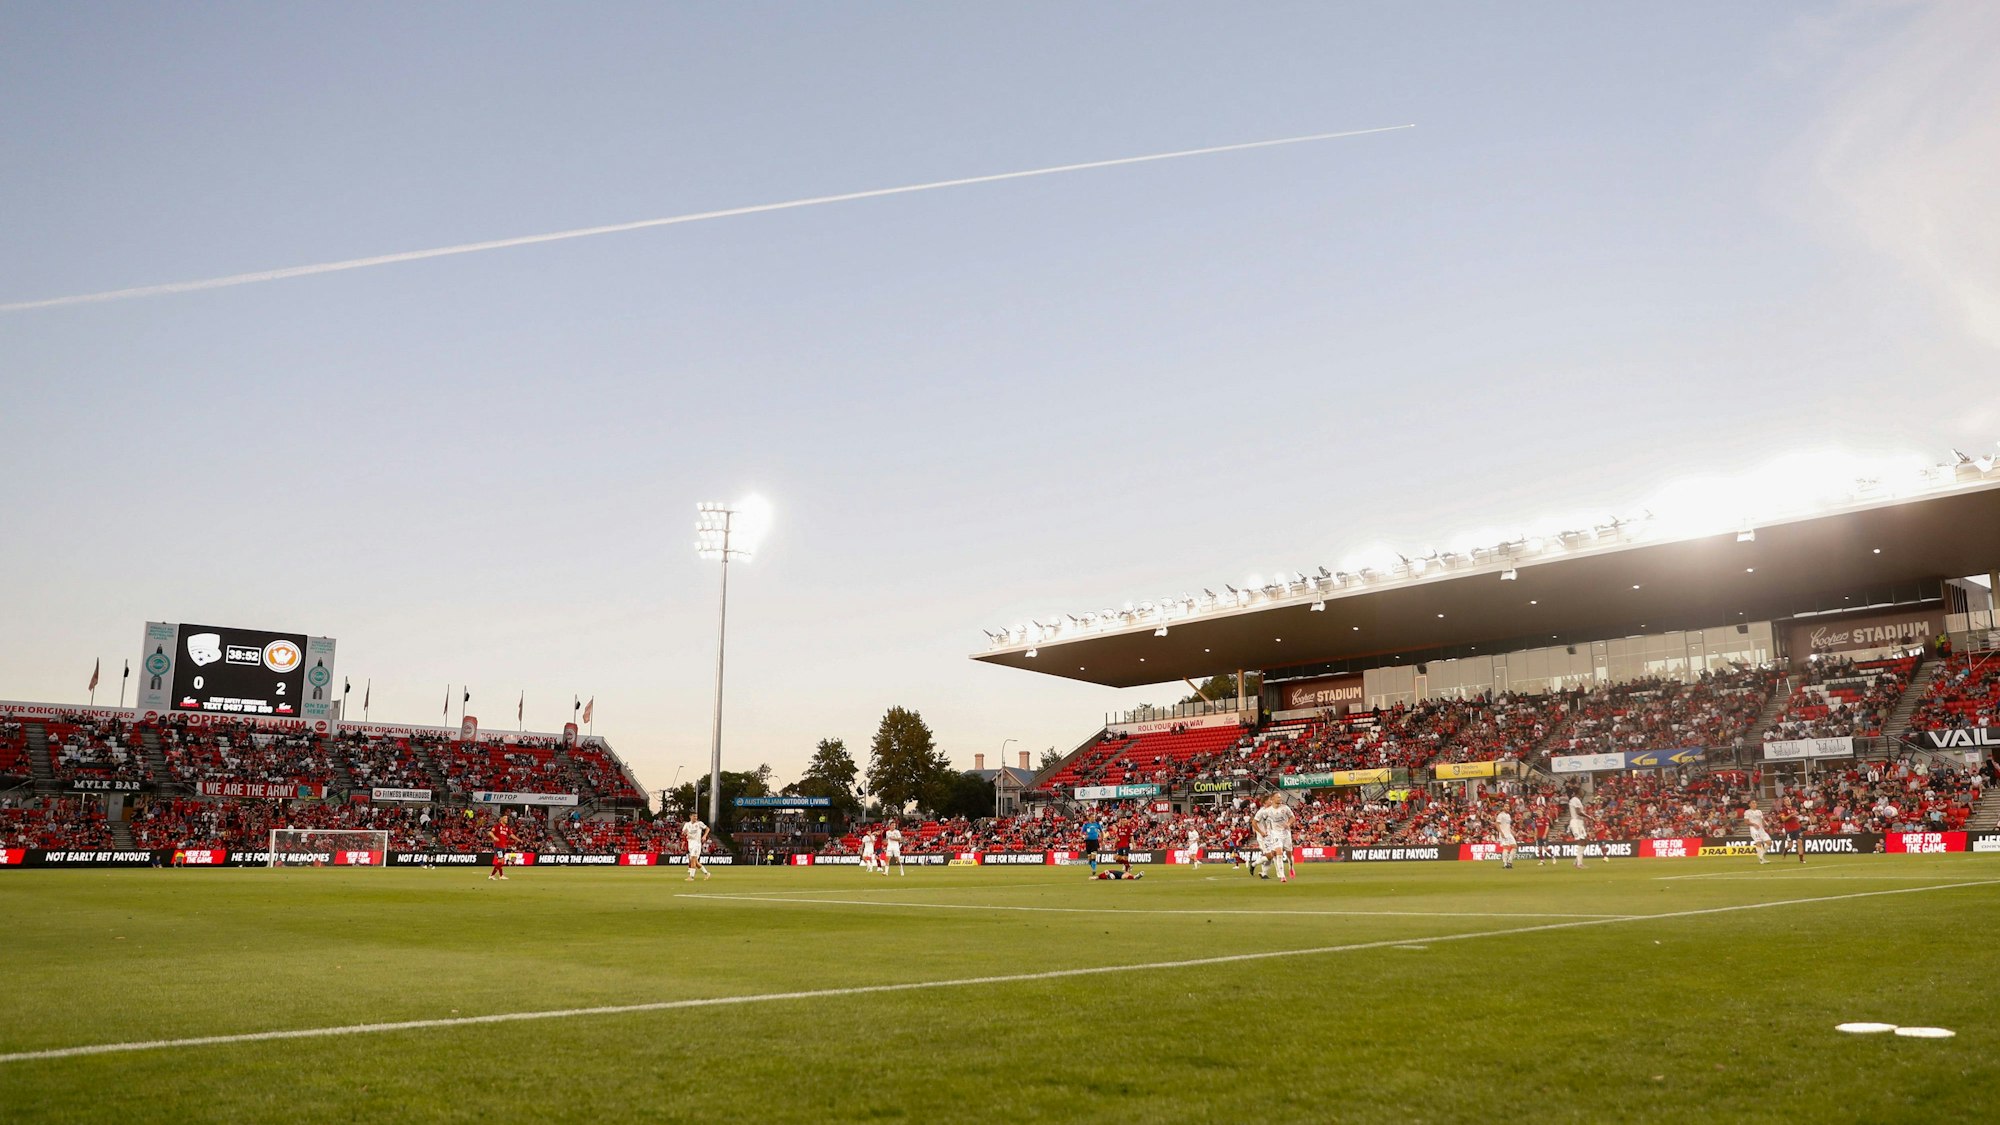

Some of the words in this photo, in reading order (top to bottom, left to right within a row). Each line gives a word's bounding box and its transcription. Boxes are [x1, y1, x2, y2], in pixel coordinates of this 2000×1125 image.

[1811, 627, 1848, 648] Coopers
[1853, 621, 1930, 643] STADIUM
[229, 650, 258, 661] 38:52
[194, 676, 204, 690] 0
[276, 682, 286, 695] 2
[1317, 686, 1361, 702] STADIUM
[203, 702, 222, 710] TEXT
[28, 706, 77, 715] ORIGINAL
[82, 709, 111, 717] SINCE
[243, 717, 306, 730] STADIUM
[1138, 724, 1153, 732] ROLL
[337, 724, 373, 732] FOREVER
[375, 726, 413, 734] ORIGINAL
[74, 780, 111, 790] MYLK
[115, 781, 140, 790] BAR
[1284, 776, 1300, 786] Kite
[206, 782, 222, 794] WE
[224, 783, 243, 795] ARE
[246, 784, 264, 796] THE
[266, 785, 294, 796] ARMY
[1119, 786, 1157, 796] Hisense
[1194, 782, 1232, 792] Comwire
[1157, 803, 1168, 812] BAR
[1902, 834, 1924, 843] HERE
[1925, 833, 1942, 842] FOR
[1653, 840, 1669, 848] HERE
[1670, 840, 1683, 848] FOR
[1906, 844, 1921, 853] THE
[1922, 843, 1946, 853] GAME
[1352, 850, 1367, 860] NOT
[1368, 849, 1391, 860] EARLY
[1392, 849, 1405, 859] BET
[1406, 848, 1438, 859] PAYOUTS
[1562, 845, 1578, 856] THE
[1655, 849, 1667, 857] THE
[1667, 848, 1686, 857] GAME
[45, 852, 64, 862] NOT
[67, 852, 95, 862] EARLY
[97, 852, 111, 862] BET
[113, 852, 150, 862] PAYOUTS
[253, 853, 270, 862] FOR
[398, 854, 412, 862] NOT
[436, 855, 448, 863] BET
[448, 855, 477, 863] PAYOUTS
[539, 855, 556, 863] HERE
[582, 855, 615, 864] MEMORIES
[985, 854, 996, 863] HERE
[997, 855, 1007, 863] FOR
[1008, 855, 1016, 863] THE
[1017, 854, 1043, 863] MEMORIES
[1101, 854, 1116, 863] EARL
[1128, 853, 1151, 862] PAYOUTS
[1240, 852, 1251, 860] THE
